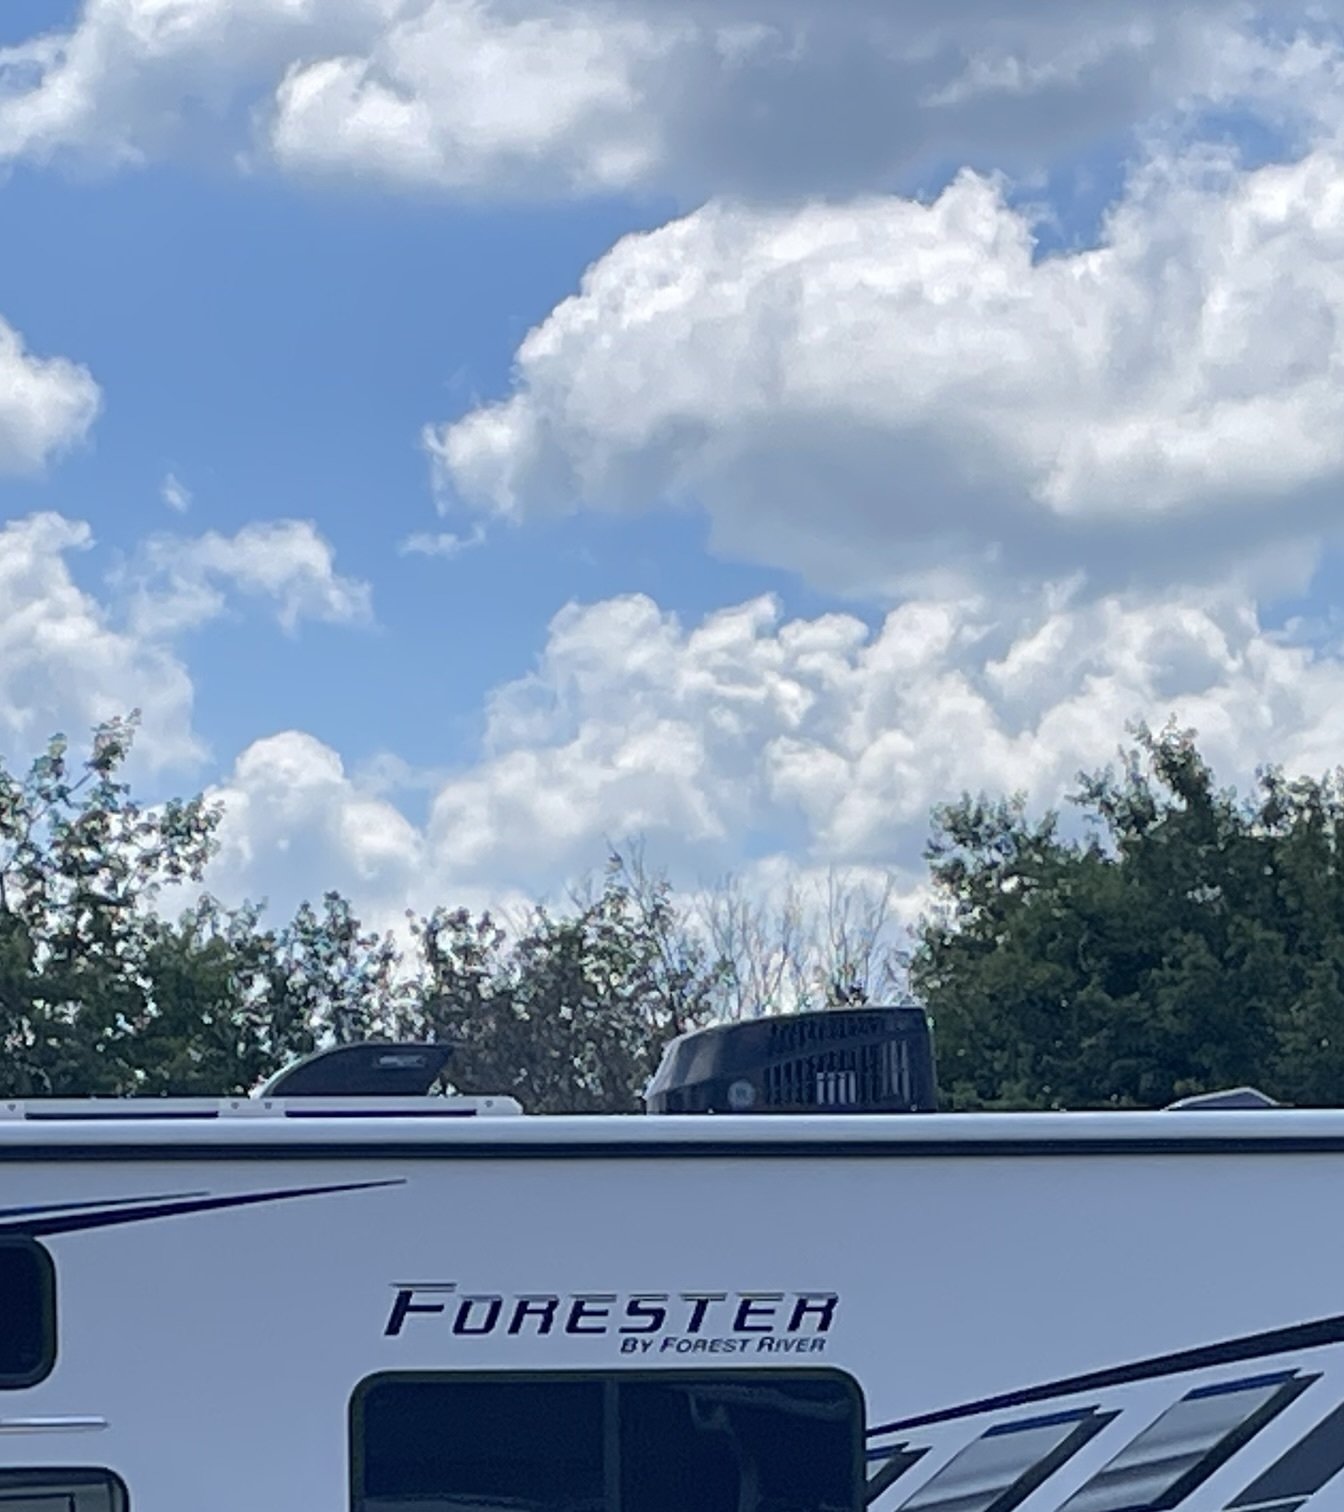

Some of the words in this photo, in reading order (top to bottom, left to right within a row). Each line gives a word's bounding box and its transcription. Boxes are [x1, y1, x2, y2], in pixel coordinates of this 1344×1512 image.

[384, 1282, 839, 1336] FORESTER
[659, 1336, 751, 1353] FOREST
[756, 1336, 827, 1353] RIVER
